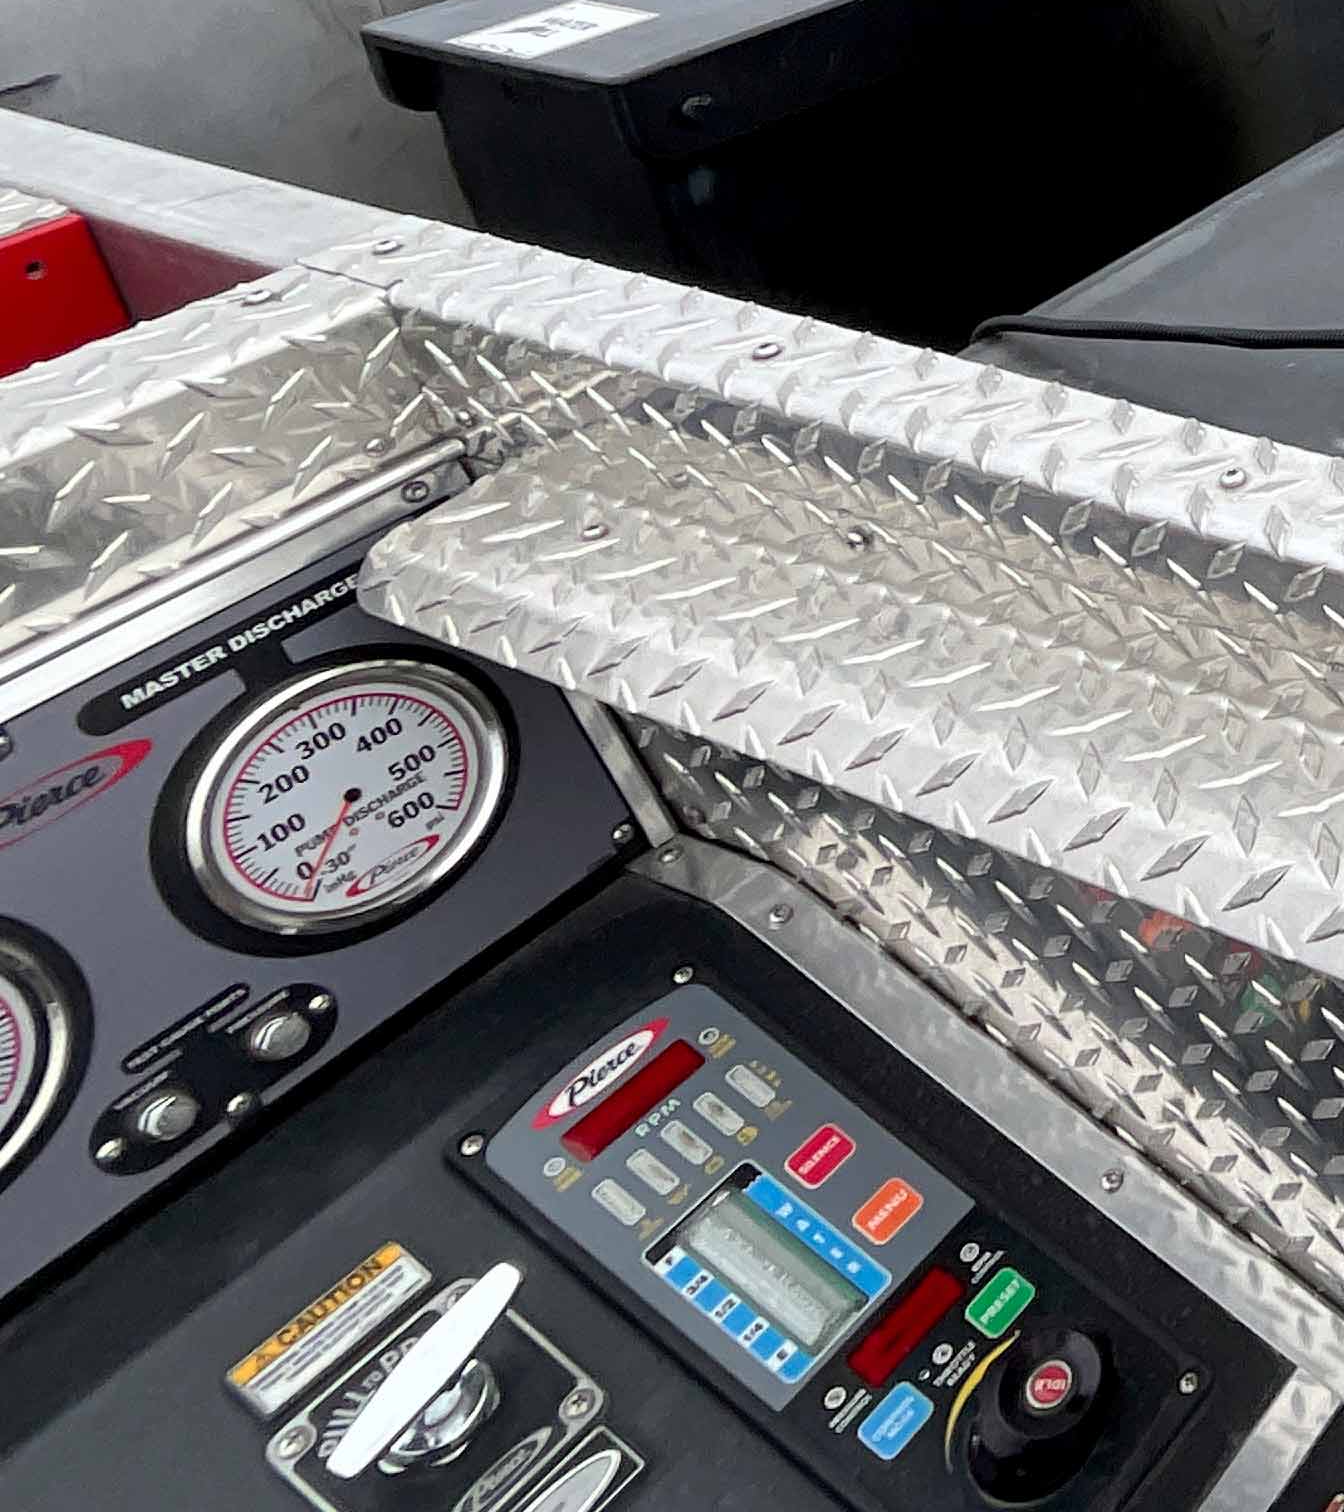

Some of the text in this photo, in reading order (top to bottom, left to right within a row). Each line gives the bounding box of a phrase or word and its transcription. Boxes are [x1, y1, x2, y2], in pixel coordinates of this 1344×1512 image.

[120, 573, 359, 710] MASTER DISCHARGE
[296, 722, 346, 760] 300
[356, 717, 402, 752] 400
[388, 744, 436, 781] 500
[257, 764, 310, 804] 200
[294, 770, 427, 857] PUMP DISCHARGE
[387, 792, 435, 829] 600
[256, 812, 306, 851] 100
[295, 861, 315, 880] 0
[369, 846, 419, 886] Pierce
[565, 1041, 637, 1108] Pierce
[633, 1097, 683, 1138] RPM
[866, 1189, 909, 1231] MENU
[276, 1256, 383, 1345] CAUTION
[686, 1274, 709, 1296] 3/4
[979, 1277, 1021, 1326] PRESET
[714, 1298, 738, 1320] 1/2
